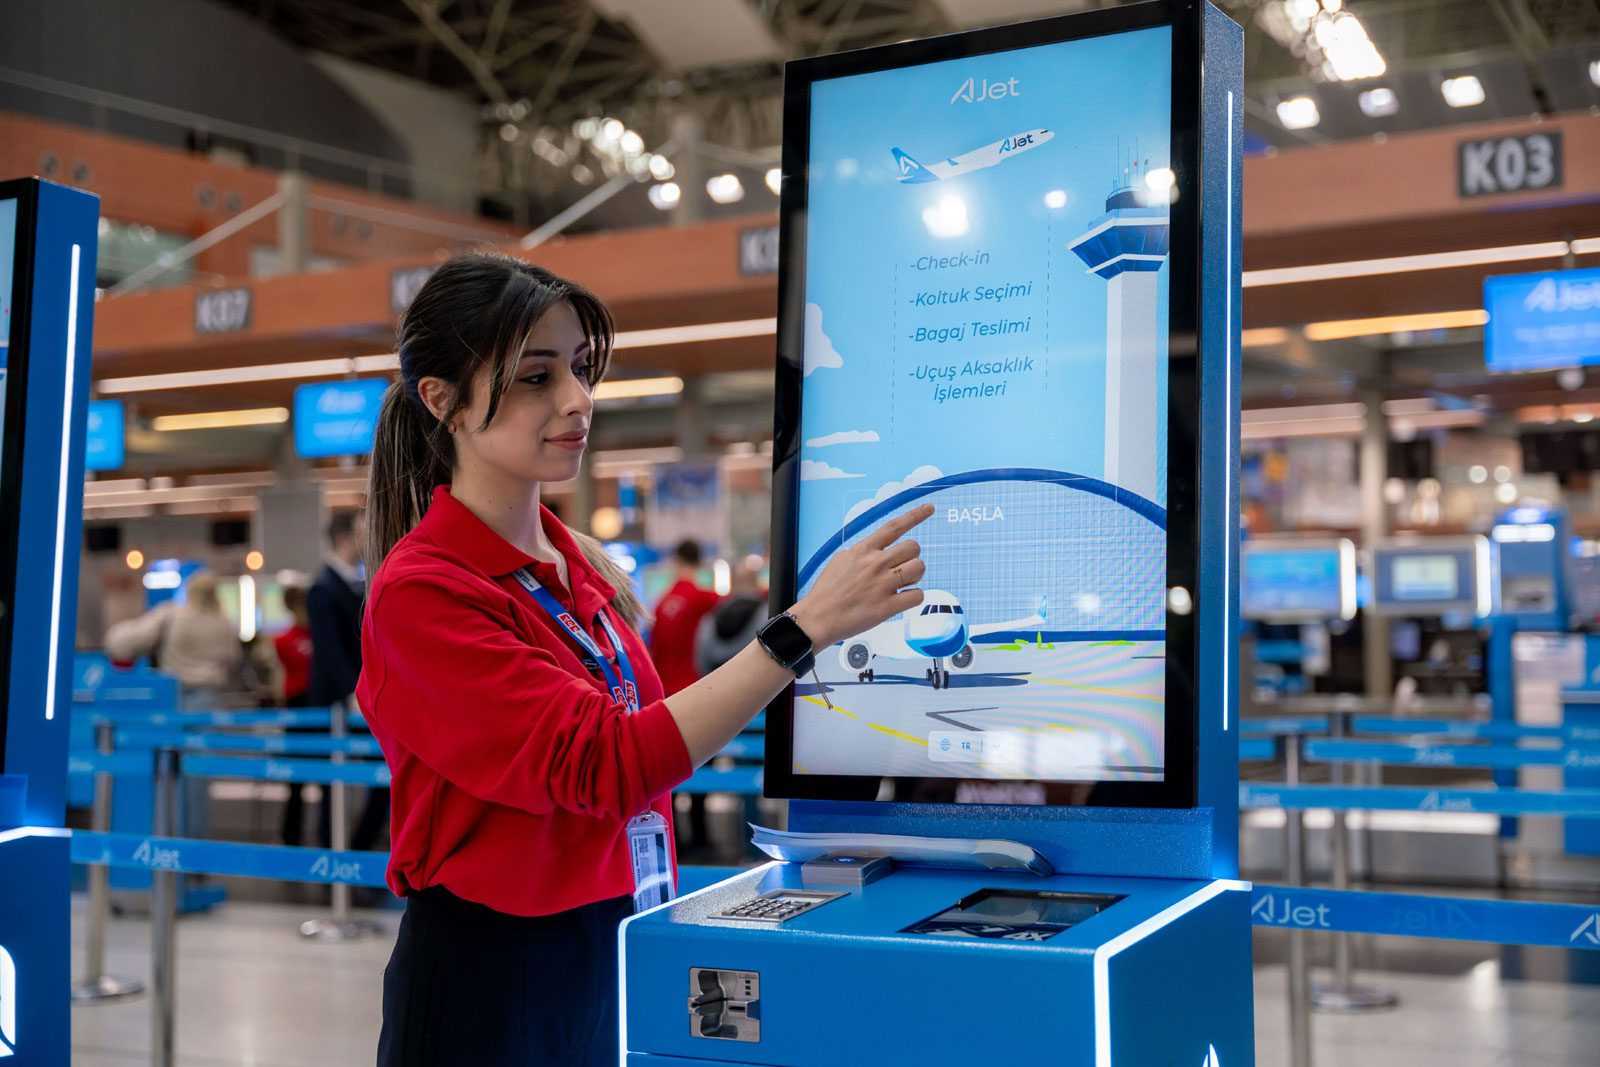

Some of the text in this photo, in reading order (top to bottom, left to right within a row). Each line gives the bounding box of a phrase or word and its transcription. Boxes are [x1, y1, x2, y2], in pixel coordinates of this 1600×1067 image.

[951, 77, 1020, 104] AJet
[999, 133, 1034, 153] AJet
[1463, 134, 1554, 194] K03
[909, 250, 990, 271] -Check-in
[909, 280, 1033, 307] -Koltuk Seçimi
[908, 317, 1032, 344] -Bagaj Teslimi
[908, 356, 1034, 382] -Uçuş Aksaklık
[934, 380, 1007, 403] İşlemleri
[947, 505, 1004, 526] BAŞLA
[1251, 894, 1331, 928] AJet
